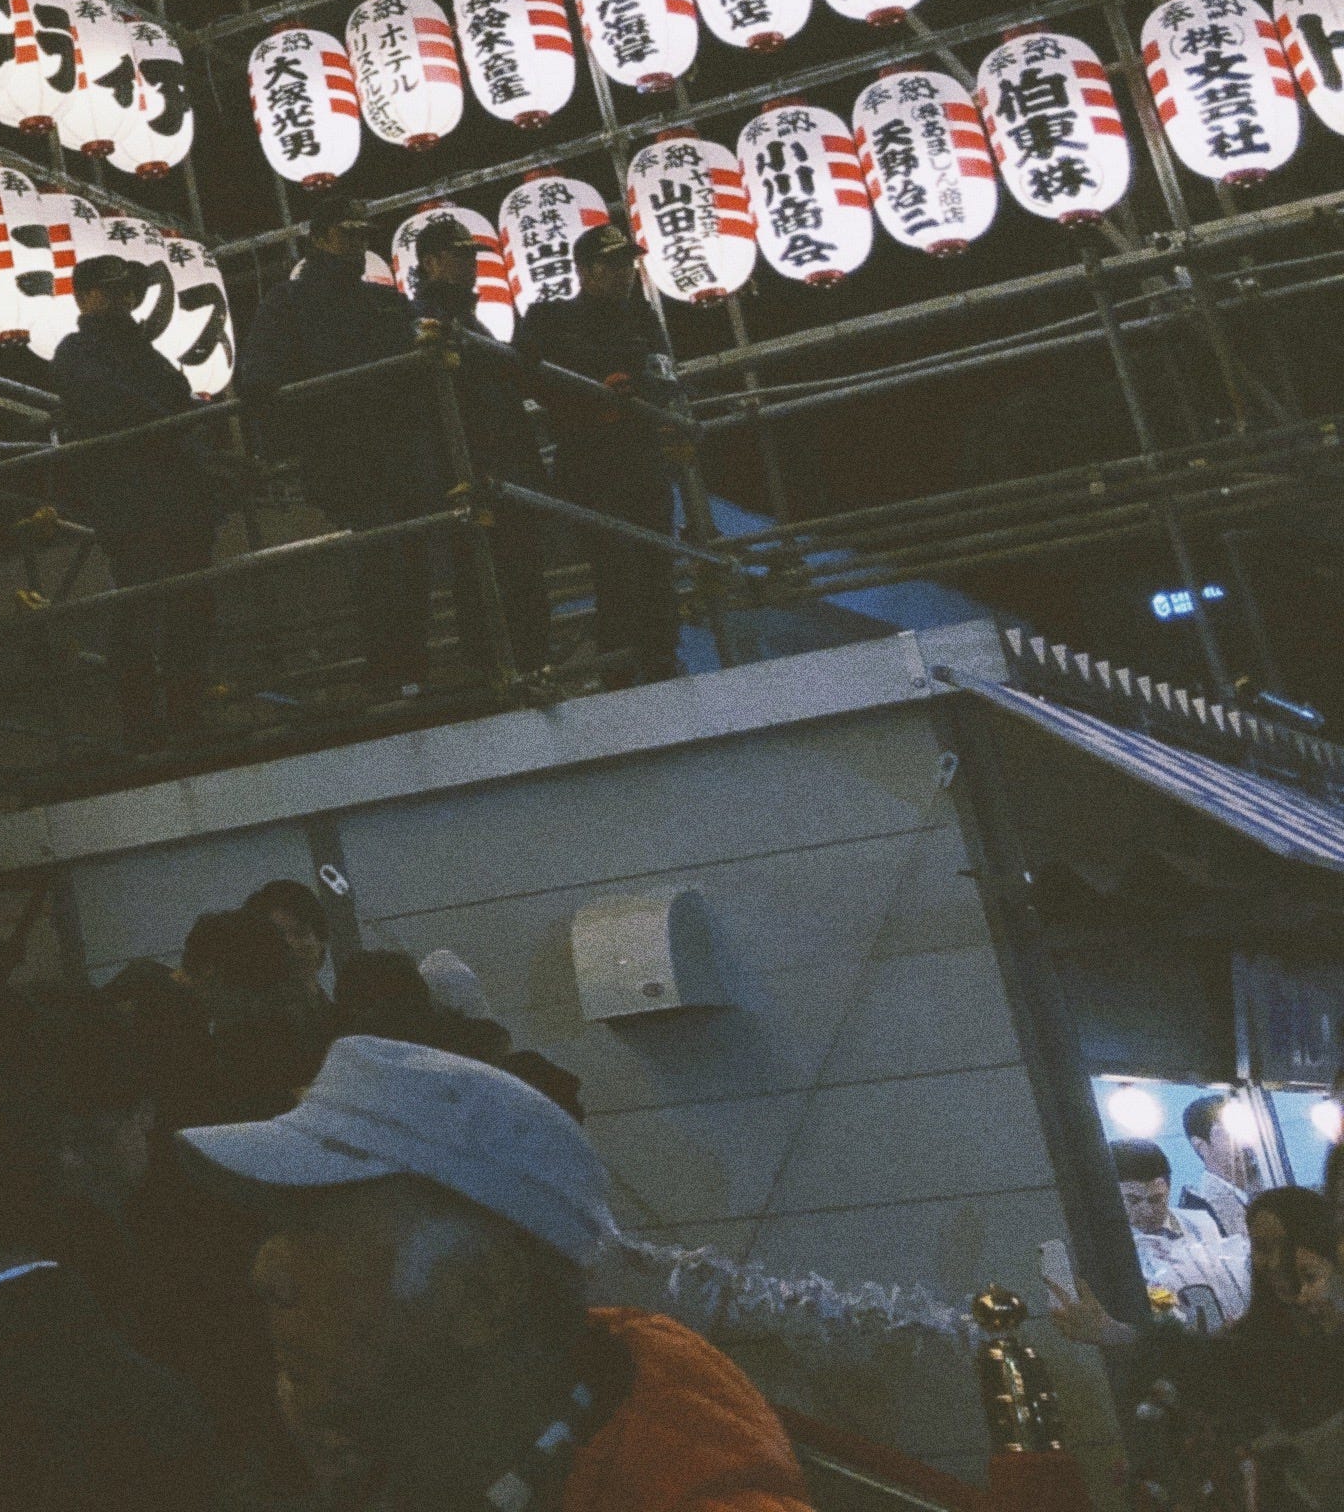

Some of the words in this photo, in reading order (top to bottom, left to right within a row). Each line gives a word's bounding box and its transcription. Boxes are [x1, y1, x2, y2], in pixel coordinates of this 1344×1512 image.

[264, 57, 320, 161] 大塚光男
[379, 23, 418, 92] ホテル
[757, 142, 838, 267] 小川商会
